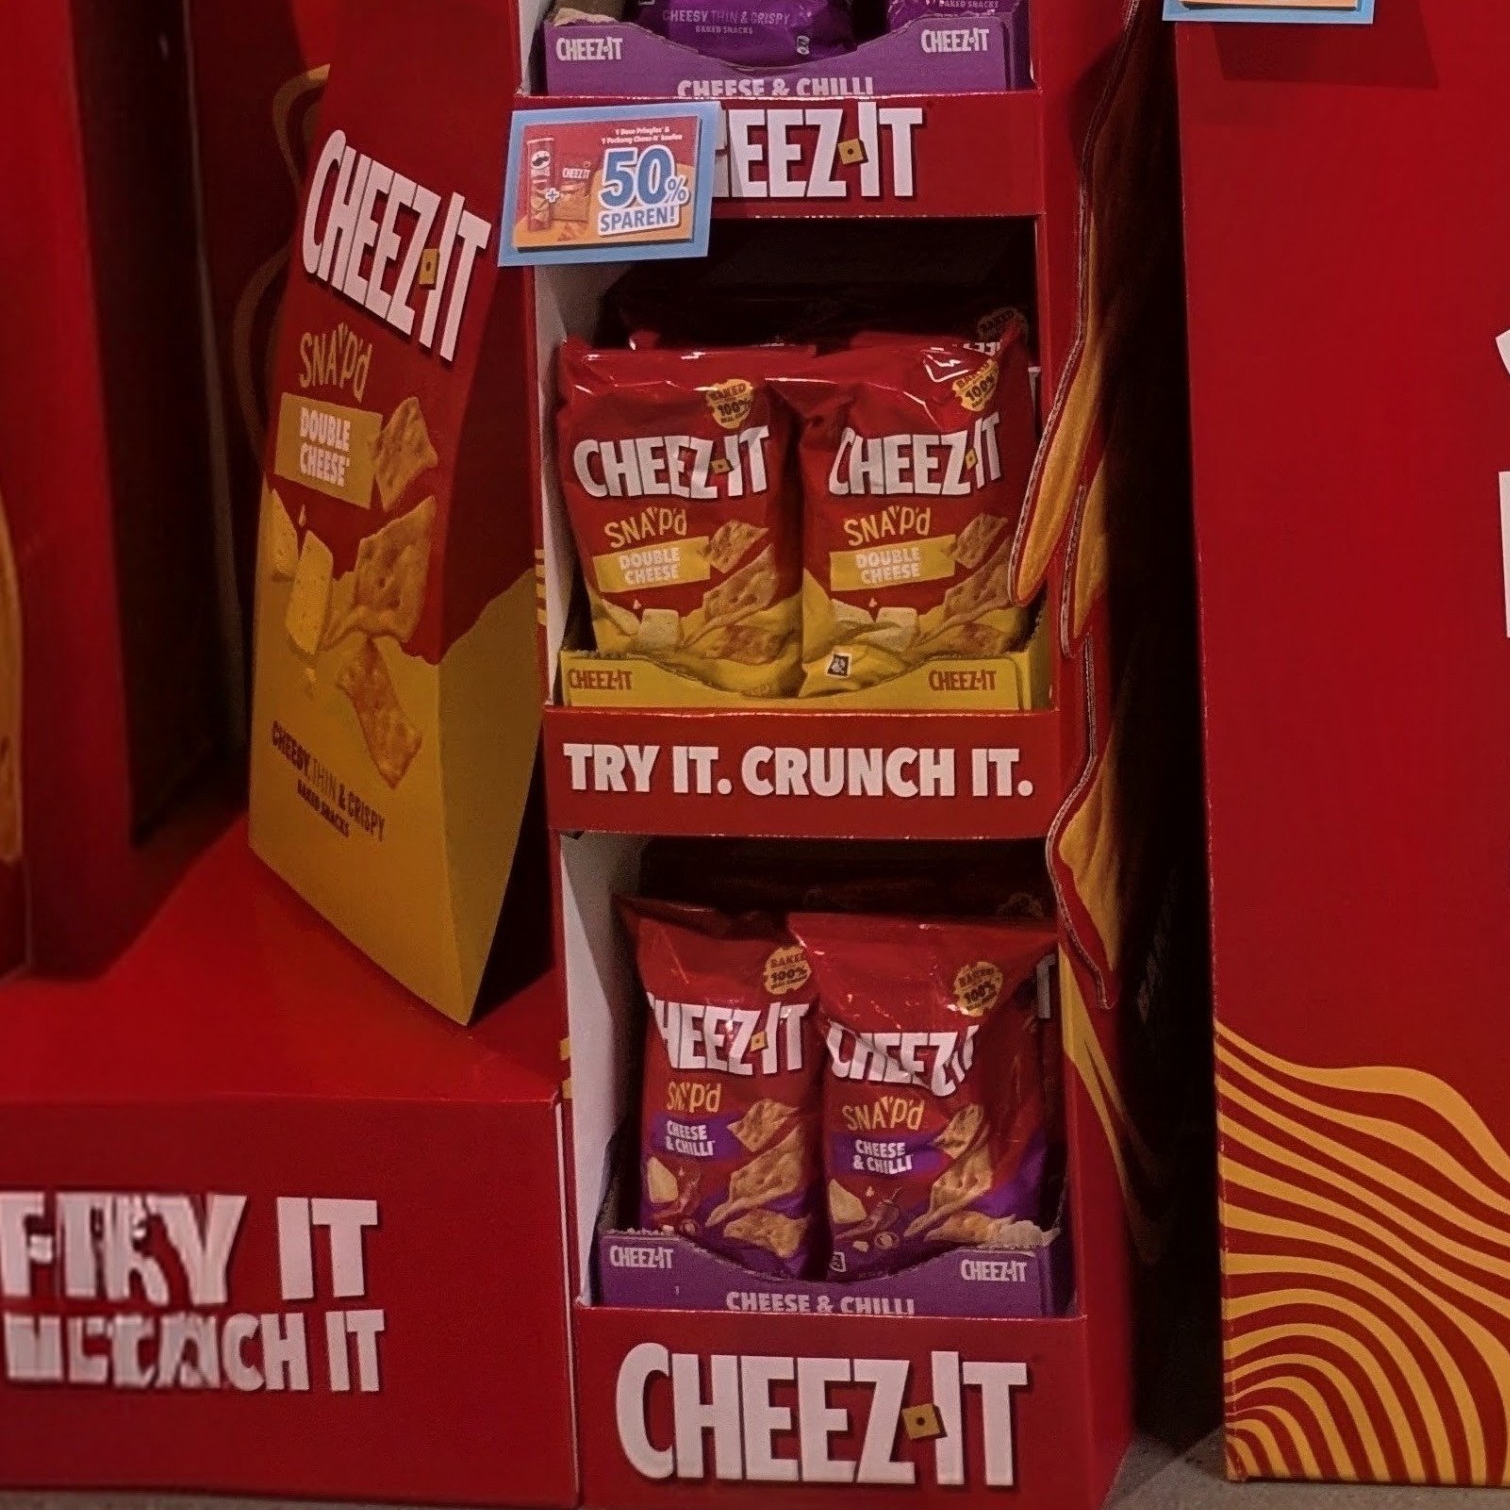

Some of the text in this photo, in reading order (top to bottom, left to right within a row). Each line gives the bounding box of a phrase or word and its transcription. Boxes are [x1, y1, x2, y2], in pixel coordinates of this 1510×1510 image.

[714, 102, 923, 197] EEZ-IT
[600, 147, 688, 208] 50%
[600, 205, 676, 233] SPAREN!
[300, 406, 351, 452] DOUBLE
[300, 442, 351, 488] CHEESE
[618, 547, 681, 571] DOUBLE
[855, 547, 921, 571] DOUBLE
[624, 565, 680, 585] CHEESE
[861, 564, 921, 585] CHEESE
[563, 742, 1034, 798] TRY IT. CRUNCH IT.
[666, 1120, 708, 1142] CHEESE
[676, 1140, 715, 1157] CHILLI
[855, 1139, 906, 1159] CHEESE
[866, 1155, 913, 1175] CHILLI
[277, 1196, 379, 1301] IT
[726, 1291, 915, 1316] CHEESE & CHILLI
[325, 1309, 385, 1392] IT
